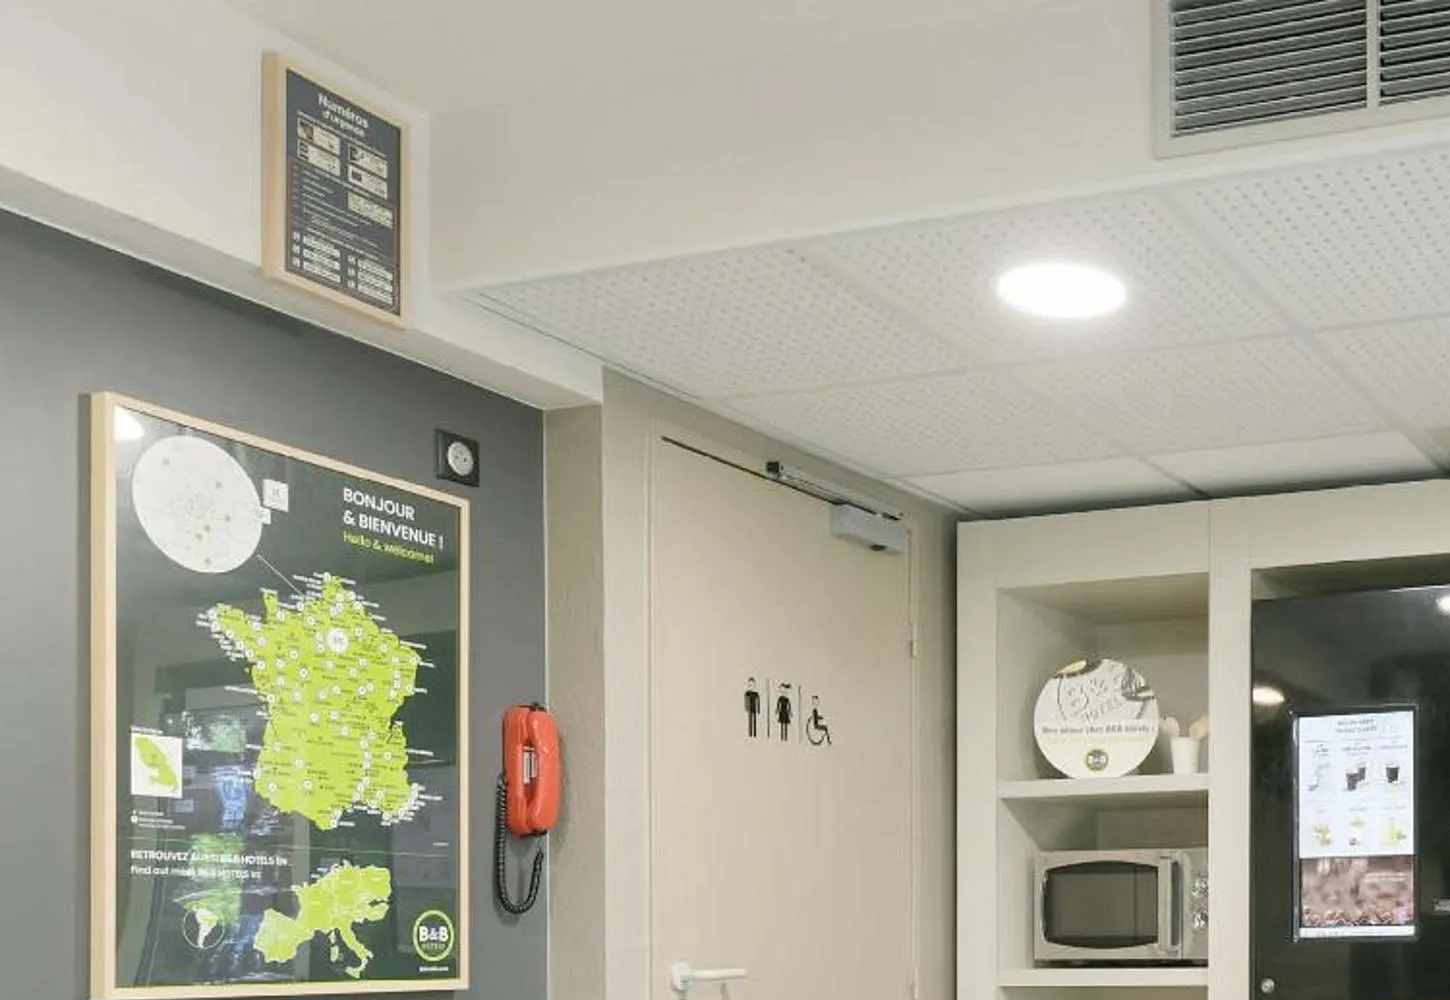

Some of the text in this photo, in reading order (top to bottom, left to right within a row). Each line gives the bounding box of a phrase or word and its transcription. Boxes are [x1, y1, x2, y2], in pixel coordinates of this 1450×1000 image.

[343, 487, 416, 521] BONJOUR
[343, 509, 356, 526] &
[358, 513, 437, 547] BIENVENUE
[343, 531, 372, 548] Hello
[419, 925, 449, 942] B&B
